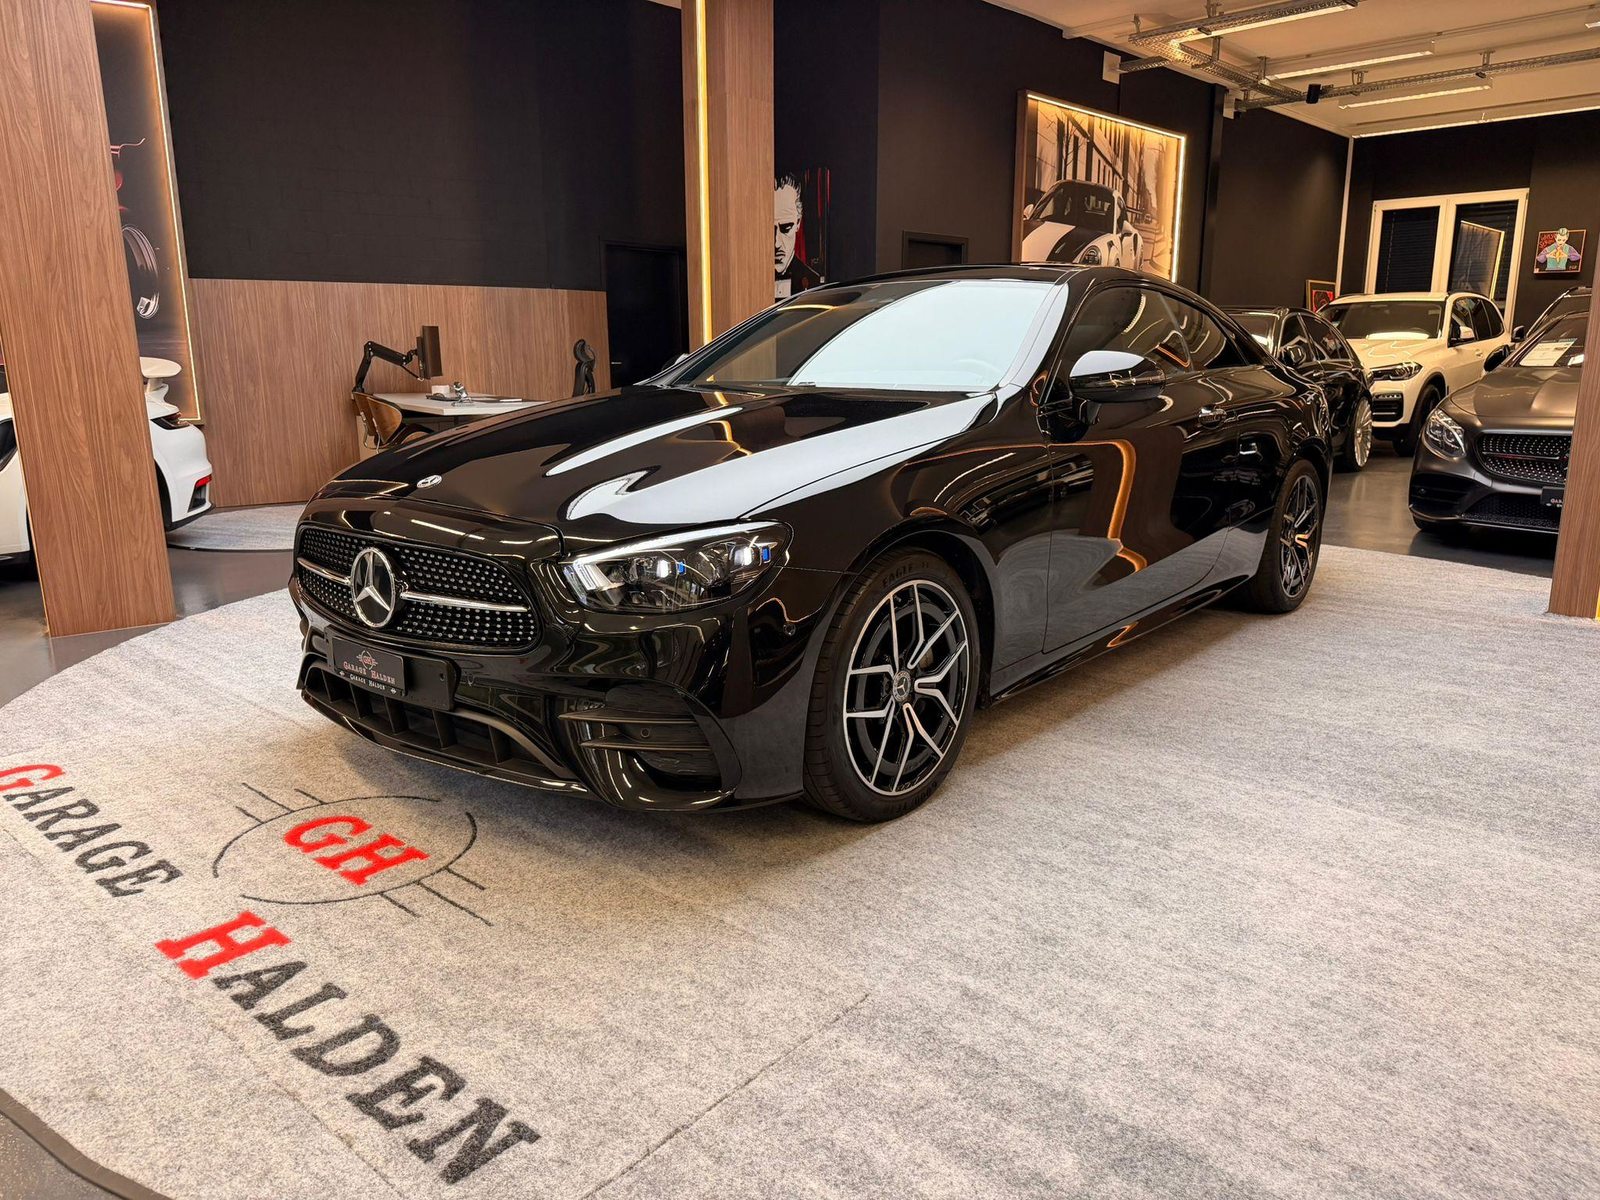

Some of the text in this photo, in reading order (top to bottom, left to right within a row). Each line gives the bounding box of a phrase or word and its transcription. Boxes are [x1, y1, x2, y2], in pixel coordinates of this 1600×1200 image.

[0, 764, 182, 897] GARAGE
[284, 815, 429, 885] GH
[155, 910, 541, 1184] HALDEN
